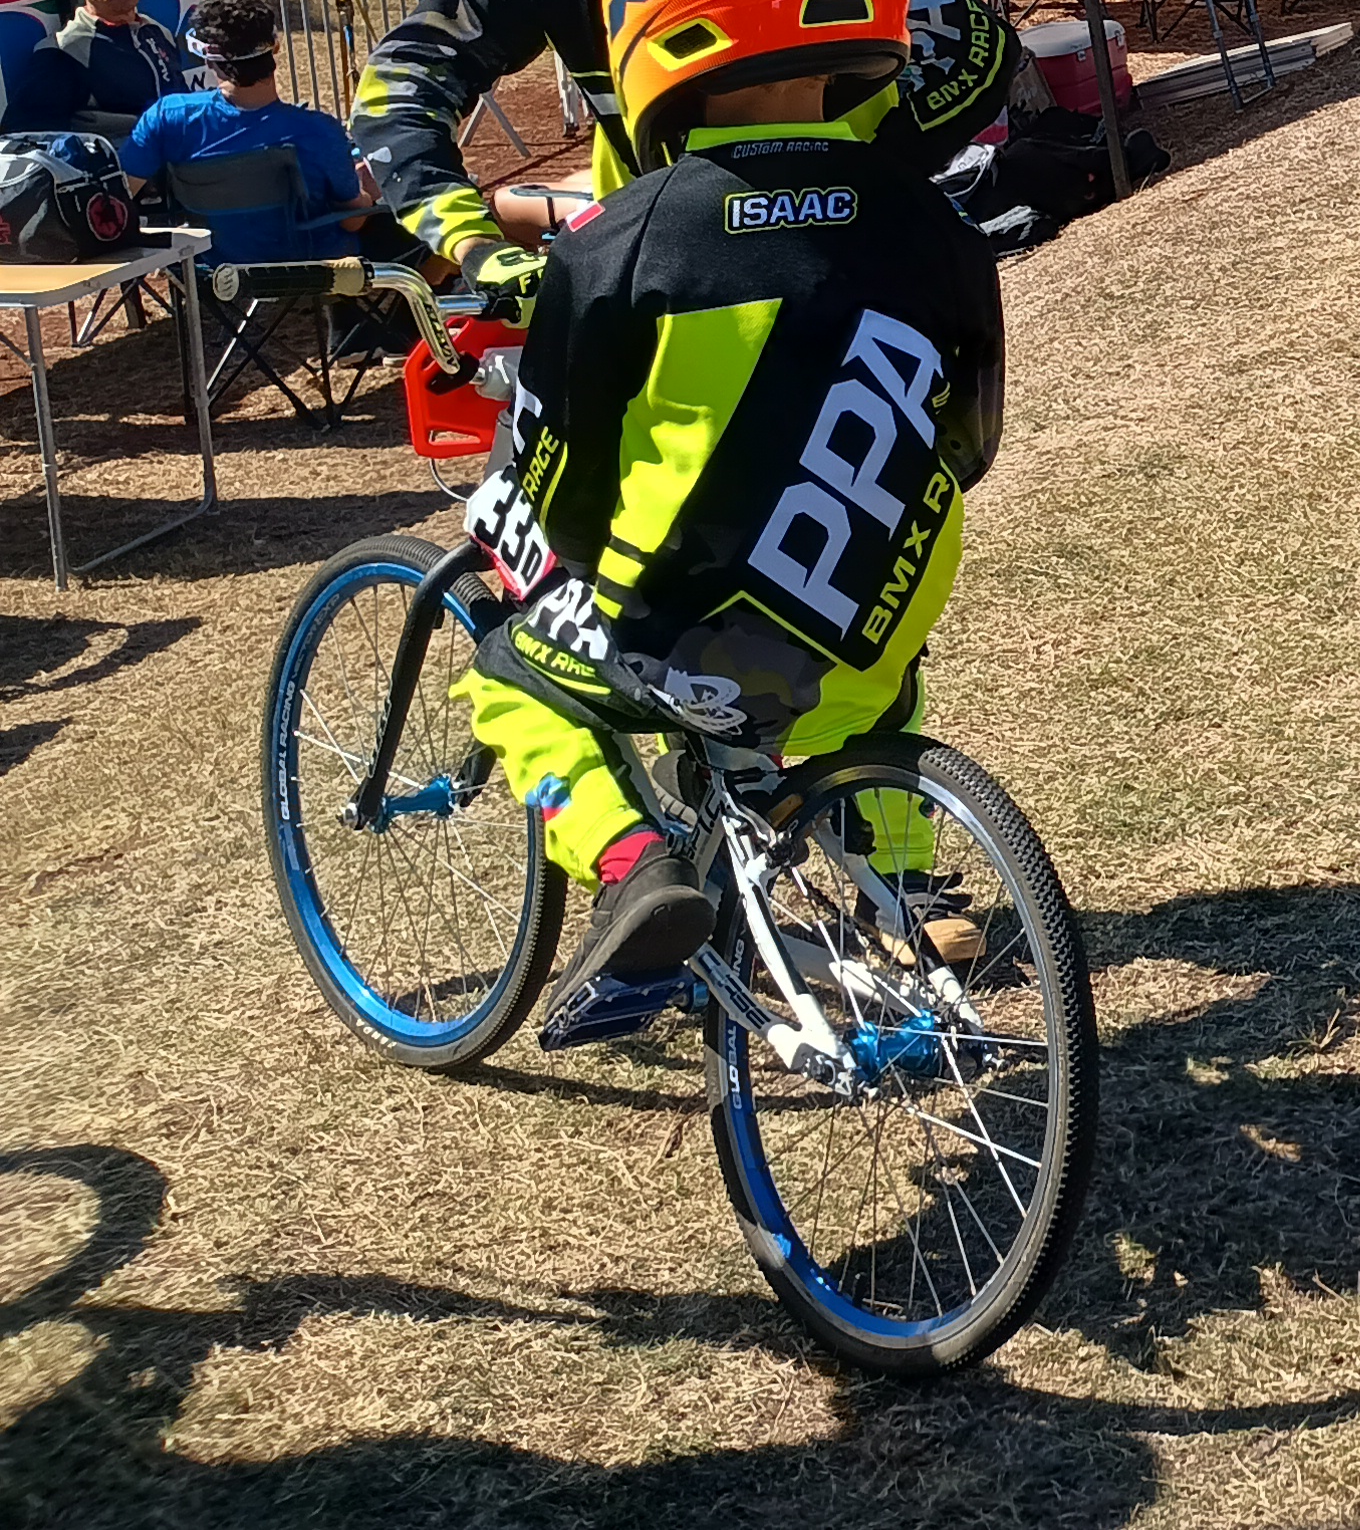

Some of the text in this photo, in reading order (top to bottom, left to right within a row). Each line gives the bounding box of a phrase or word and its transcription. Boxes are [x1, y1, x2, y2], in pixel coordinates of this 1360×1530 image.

[733, 142, 783, 159] CUSTOM
[732, 192, 851, 227] ISAAC
[522, 426, 559, 502] RACE
[748, 308, 944, 642] PPA
[861, 520, 931, 645] BMX
[279, 680, 296, 744] RACING
[277, 746, 290, 820] GLOBAL
[728, 1025, 743, 1110] GLOBAL
